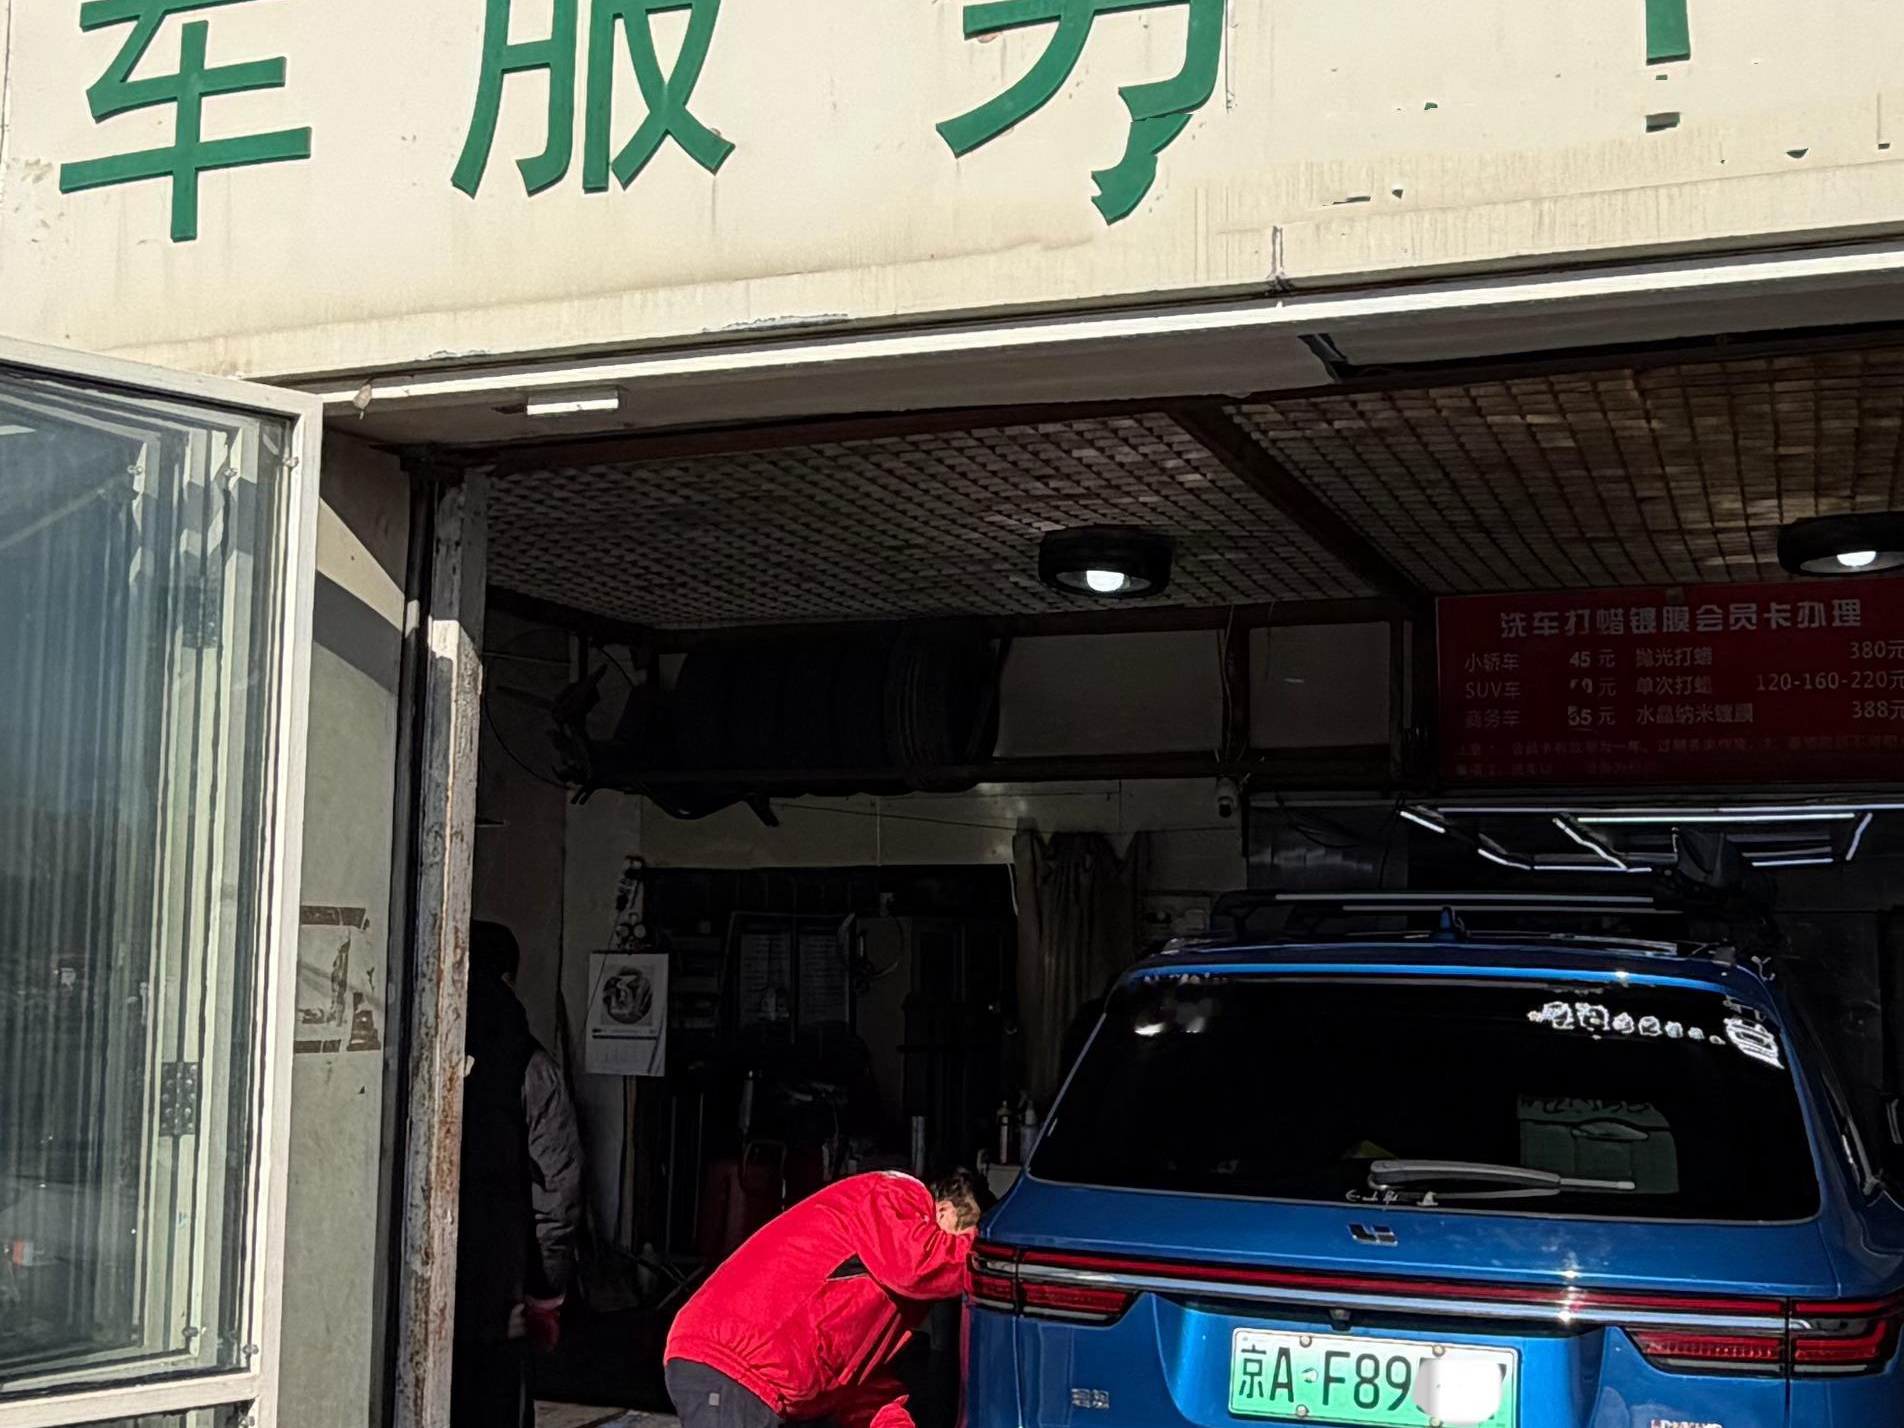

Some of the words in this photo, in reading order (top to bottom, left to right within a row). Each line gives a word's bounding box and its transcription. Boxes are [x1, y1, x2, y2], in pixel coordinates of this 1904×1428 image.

[1569, 651, 1591, 668] 45
[1597, 648, 1616, 668] 元
[1465, 681, 1521, 699] SUV车
[1598, 676, 1617, 697] 元
[1598, 705, 1616, 725] 元
